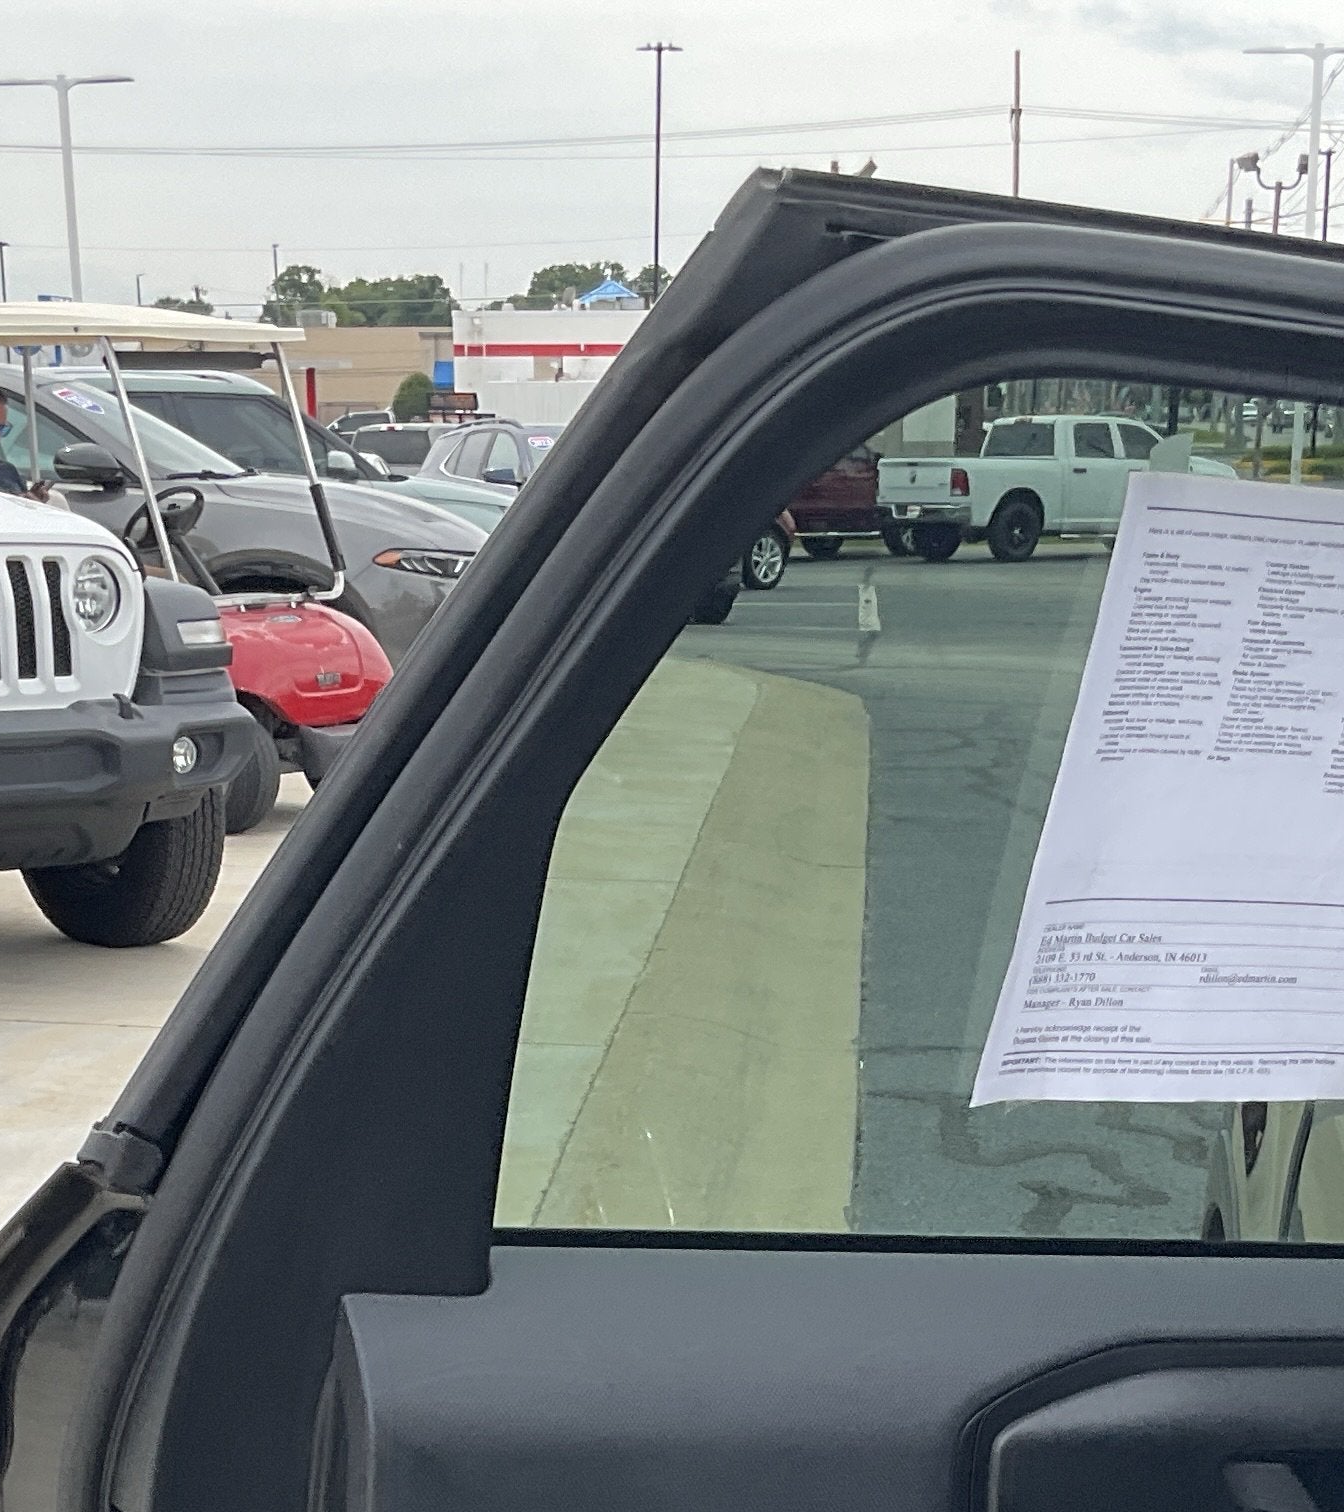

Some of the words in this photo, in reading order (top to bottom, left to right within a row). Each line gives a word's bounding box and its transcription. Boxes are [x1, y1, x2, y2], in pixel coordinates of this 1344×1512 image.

[1040, 935, 1053, 946] Ed
[1055, 934, 1083, 944] Martin
[1085, 932, 1117, 945] Budget
[1119, 932, 1136, 943] Car
[1138, 932, 1163, 943] Sales
[1115, 951, 1162, 963] Anderson,
[1164, 952, 1178, 962] IN
[1179, 952, 1208, 963] 46013
[1023, 997, 1060, 1009] Manager
[1068, 997, 1092, 1008] Ryan
[1094, 997, 1124, 1007] Dillon
